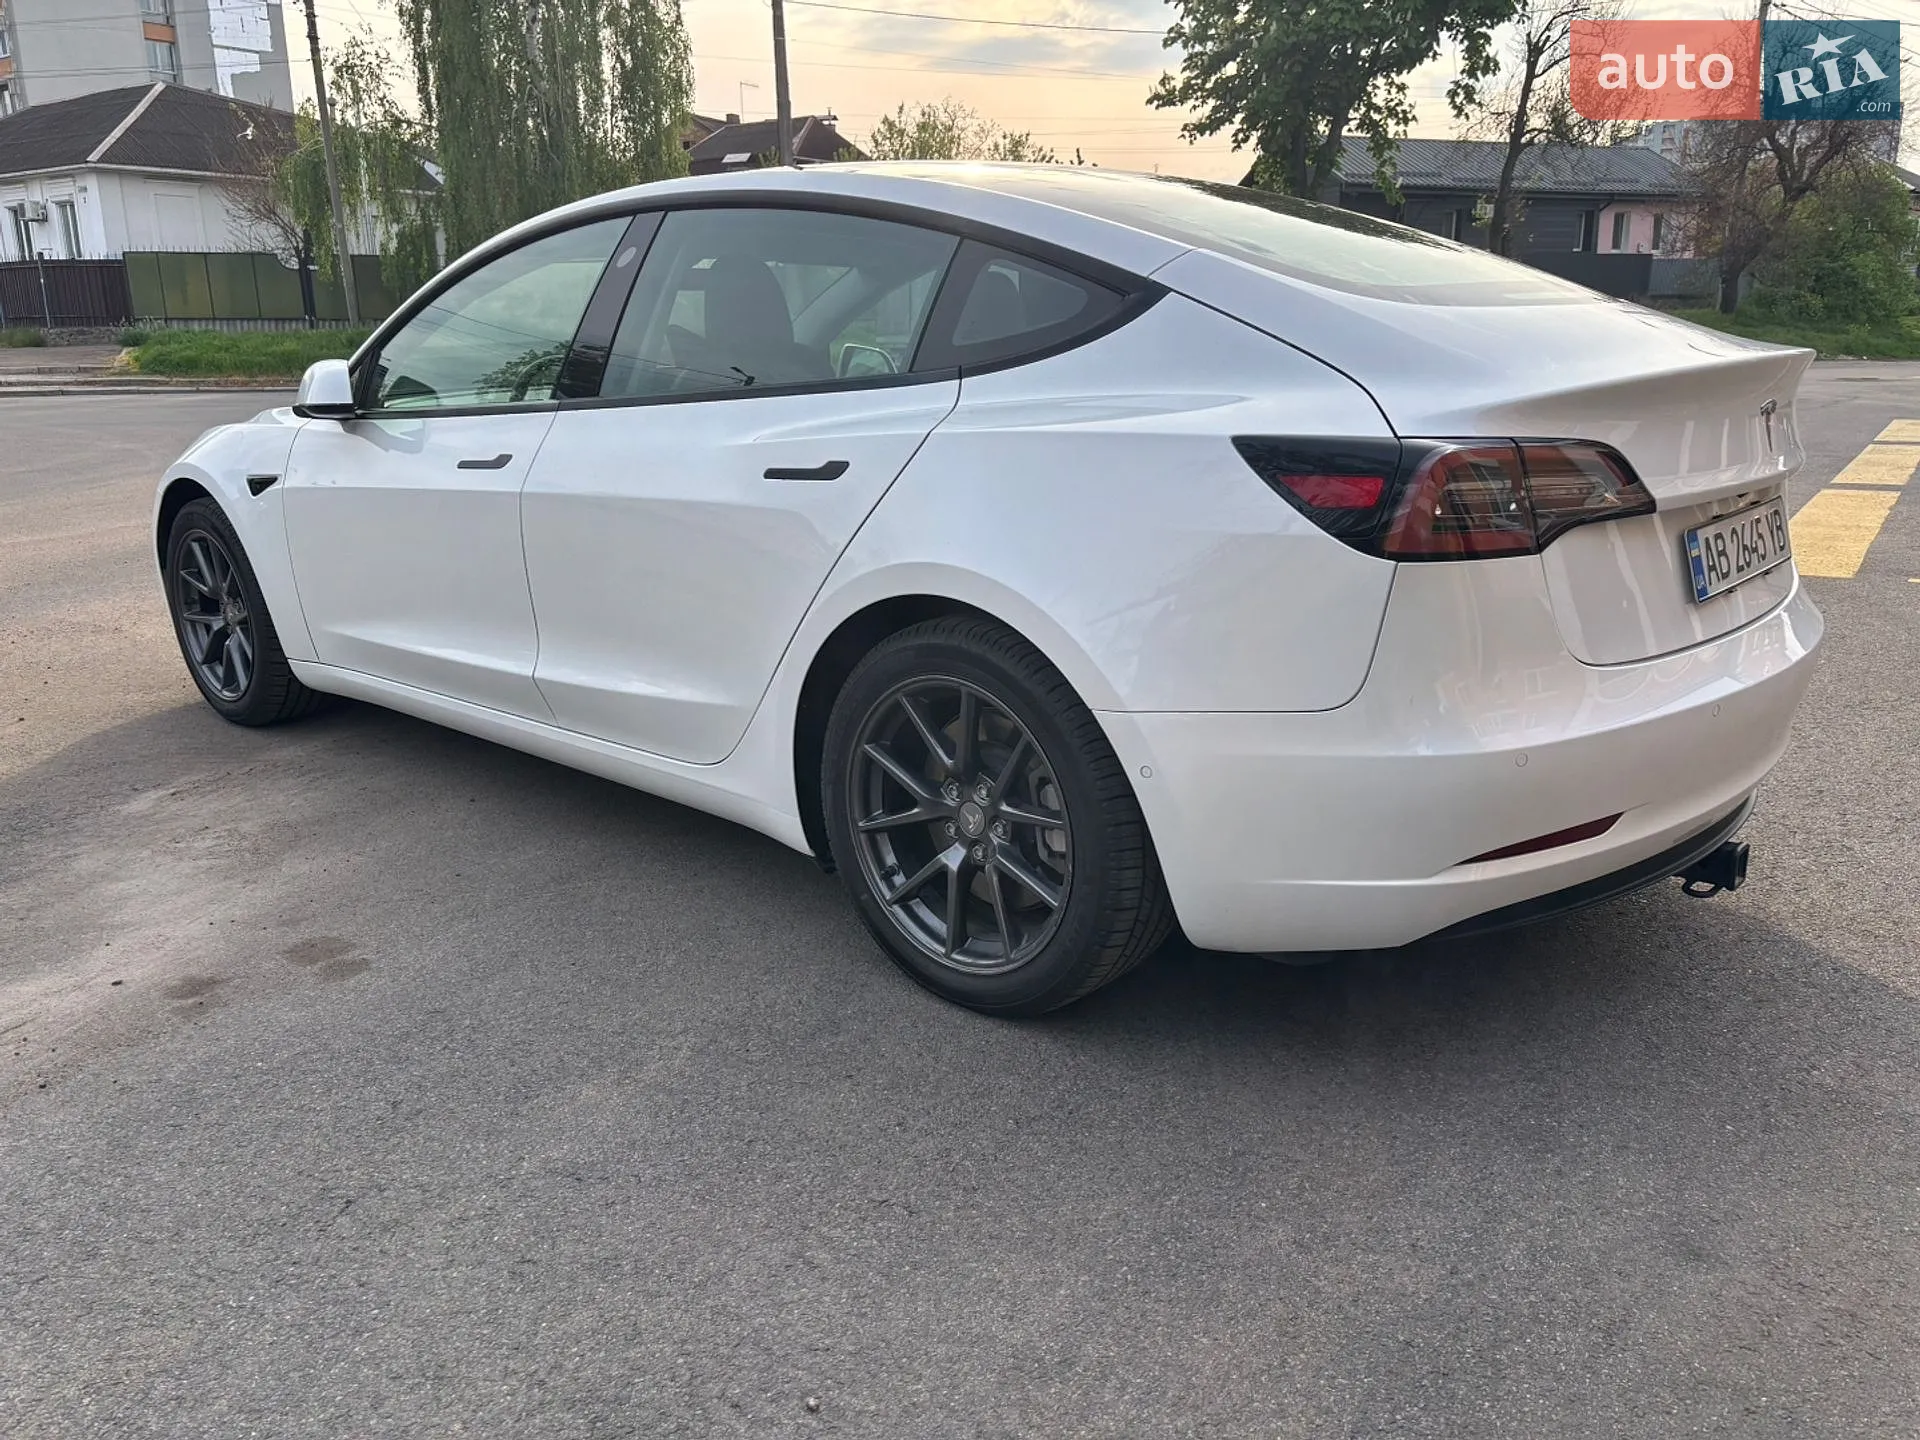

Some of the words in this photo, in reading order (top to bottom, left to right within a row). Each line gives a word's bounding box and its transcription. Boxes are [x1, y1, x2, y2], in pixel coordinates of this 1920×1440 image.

[1704, 531, 1731, 586] AB
[1730, 517, 1767, 573] 2645
[1765, 509, 1786, 555] YB
